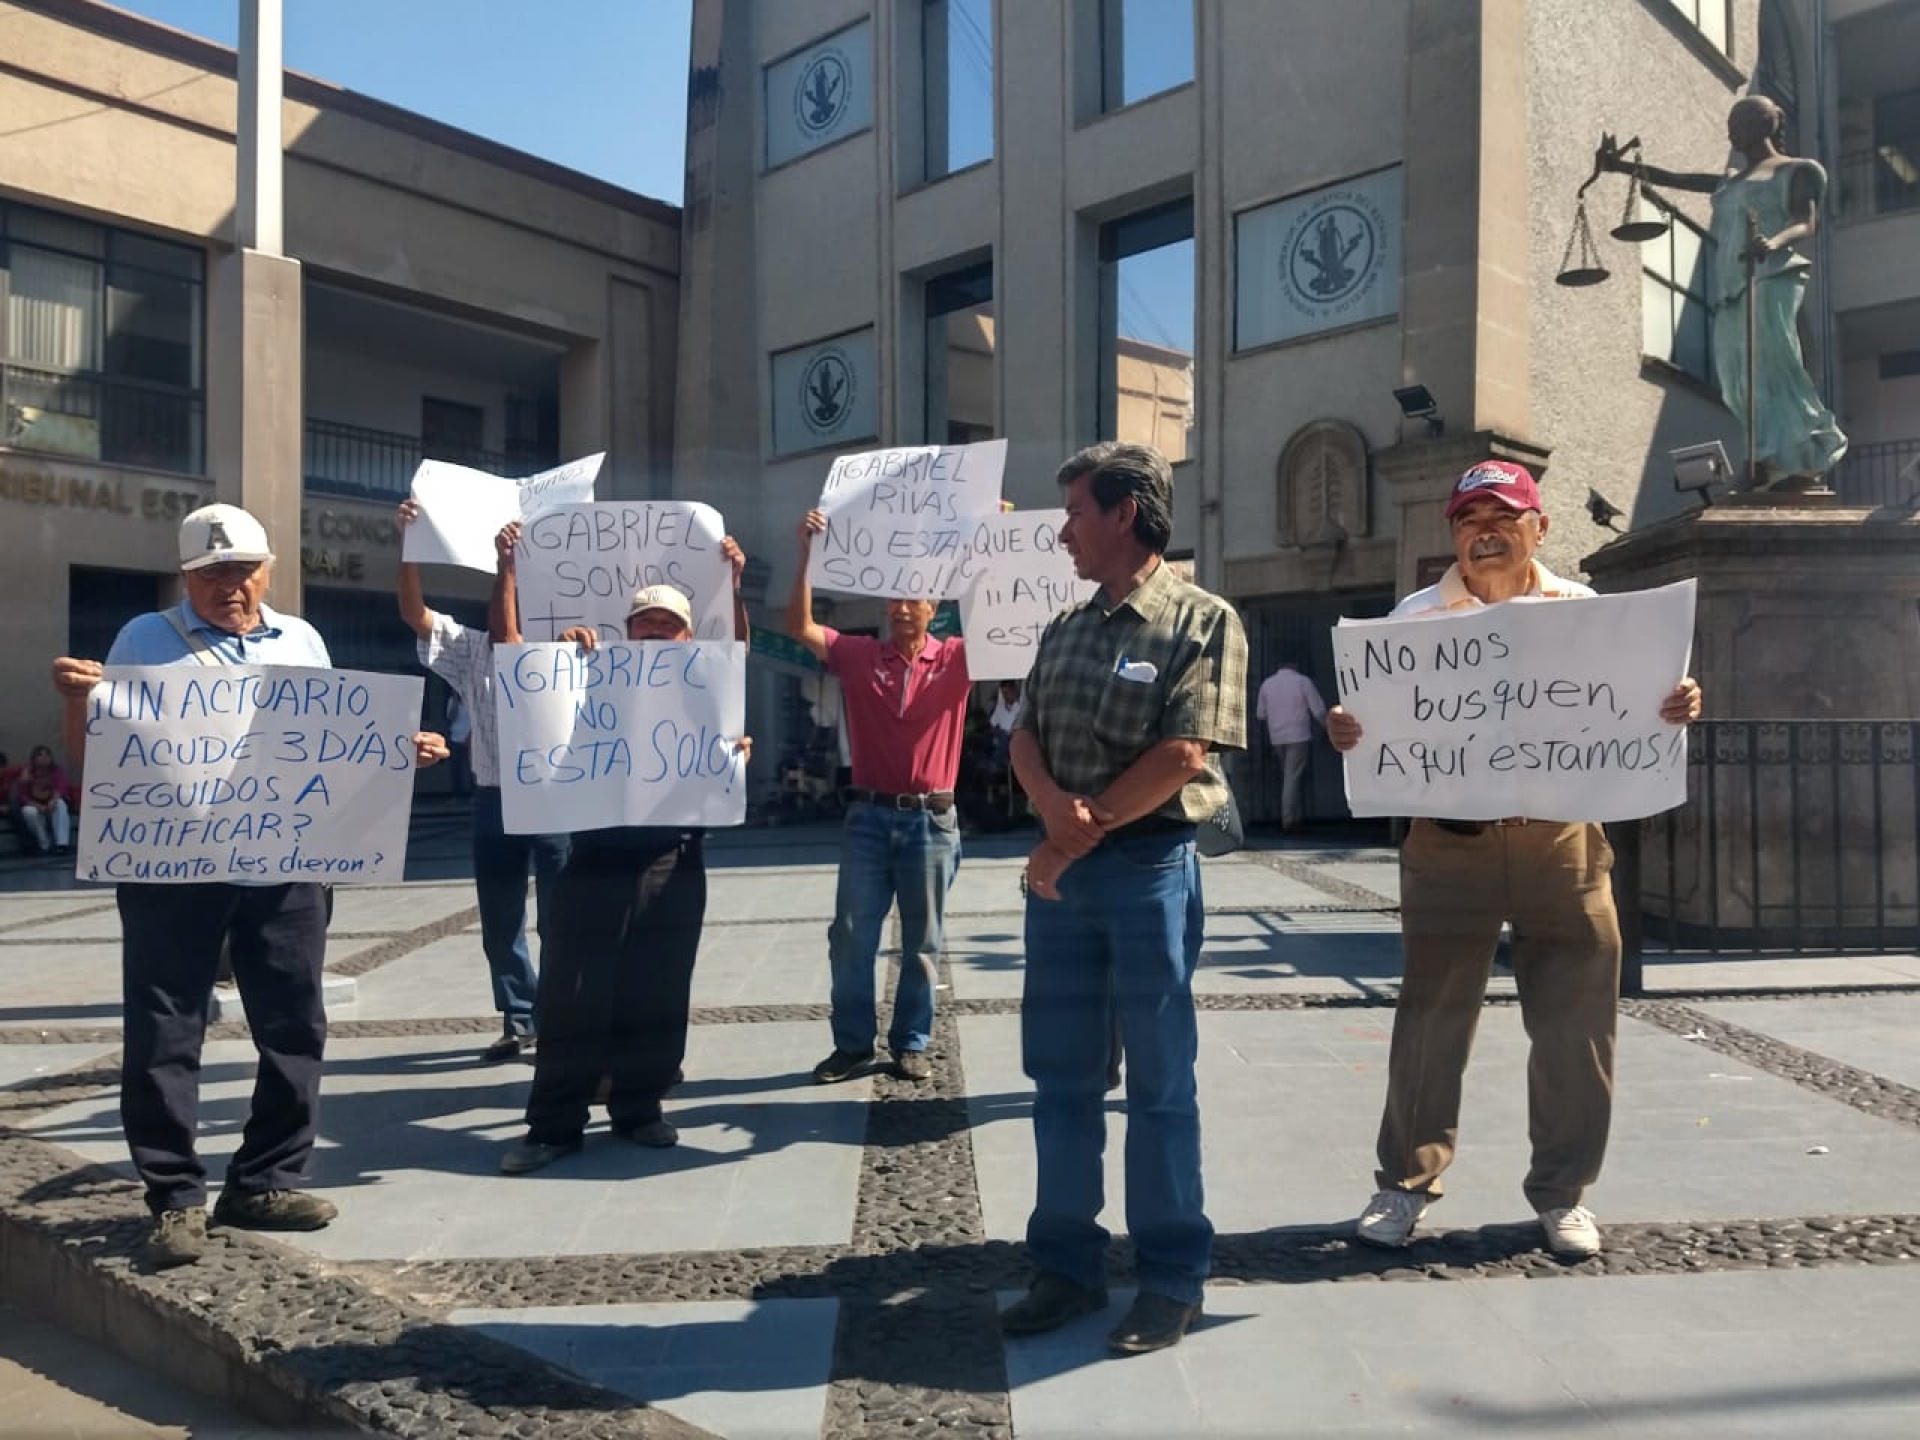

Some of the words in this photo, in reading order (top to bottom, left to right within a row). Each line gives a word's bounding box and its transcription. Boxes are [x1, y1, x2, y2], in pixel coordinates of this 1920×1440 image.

[206, 521, 234, 550] A
[823, 517, 874, 558] NO
[887, 530, 960, 559] ESTA
[1435, 632, 1510, 671] NOS
[180, 676, 370, 719] ACTUARIO
[574, 696, 617, 731] NO
[1414, 678, 1628, 722] busquen,
[118, 732, 264, 769] ACUDE
[517, 738, 631, 785] ESTA
[294, 773, 330, 805] A
